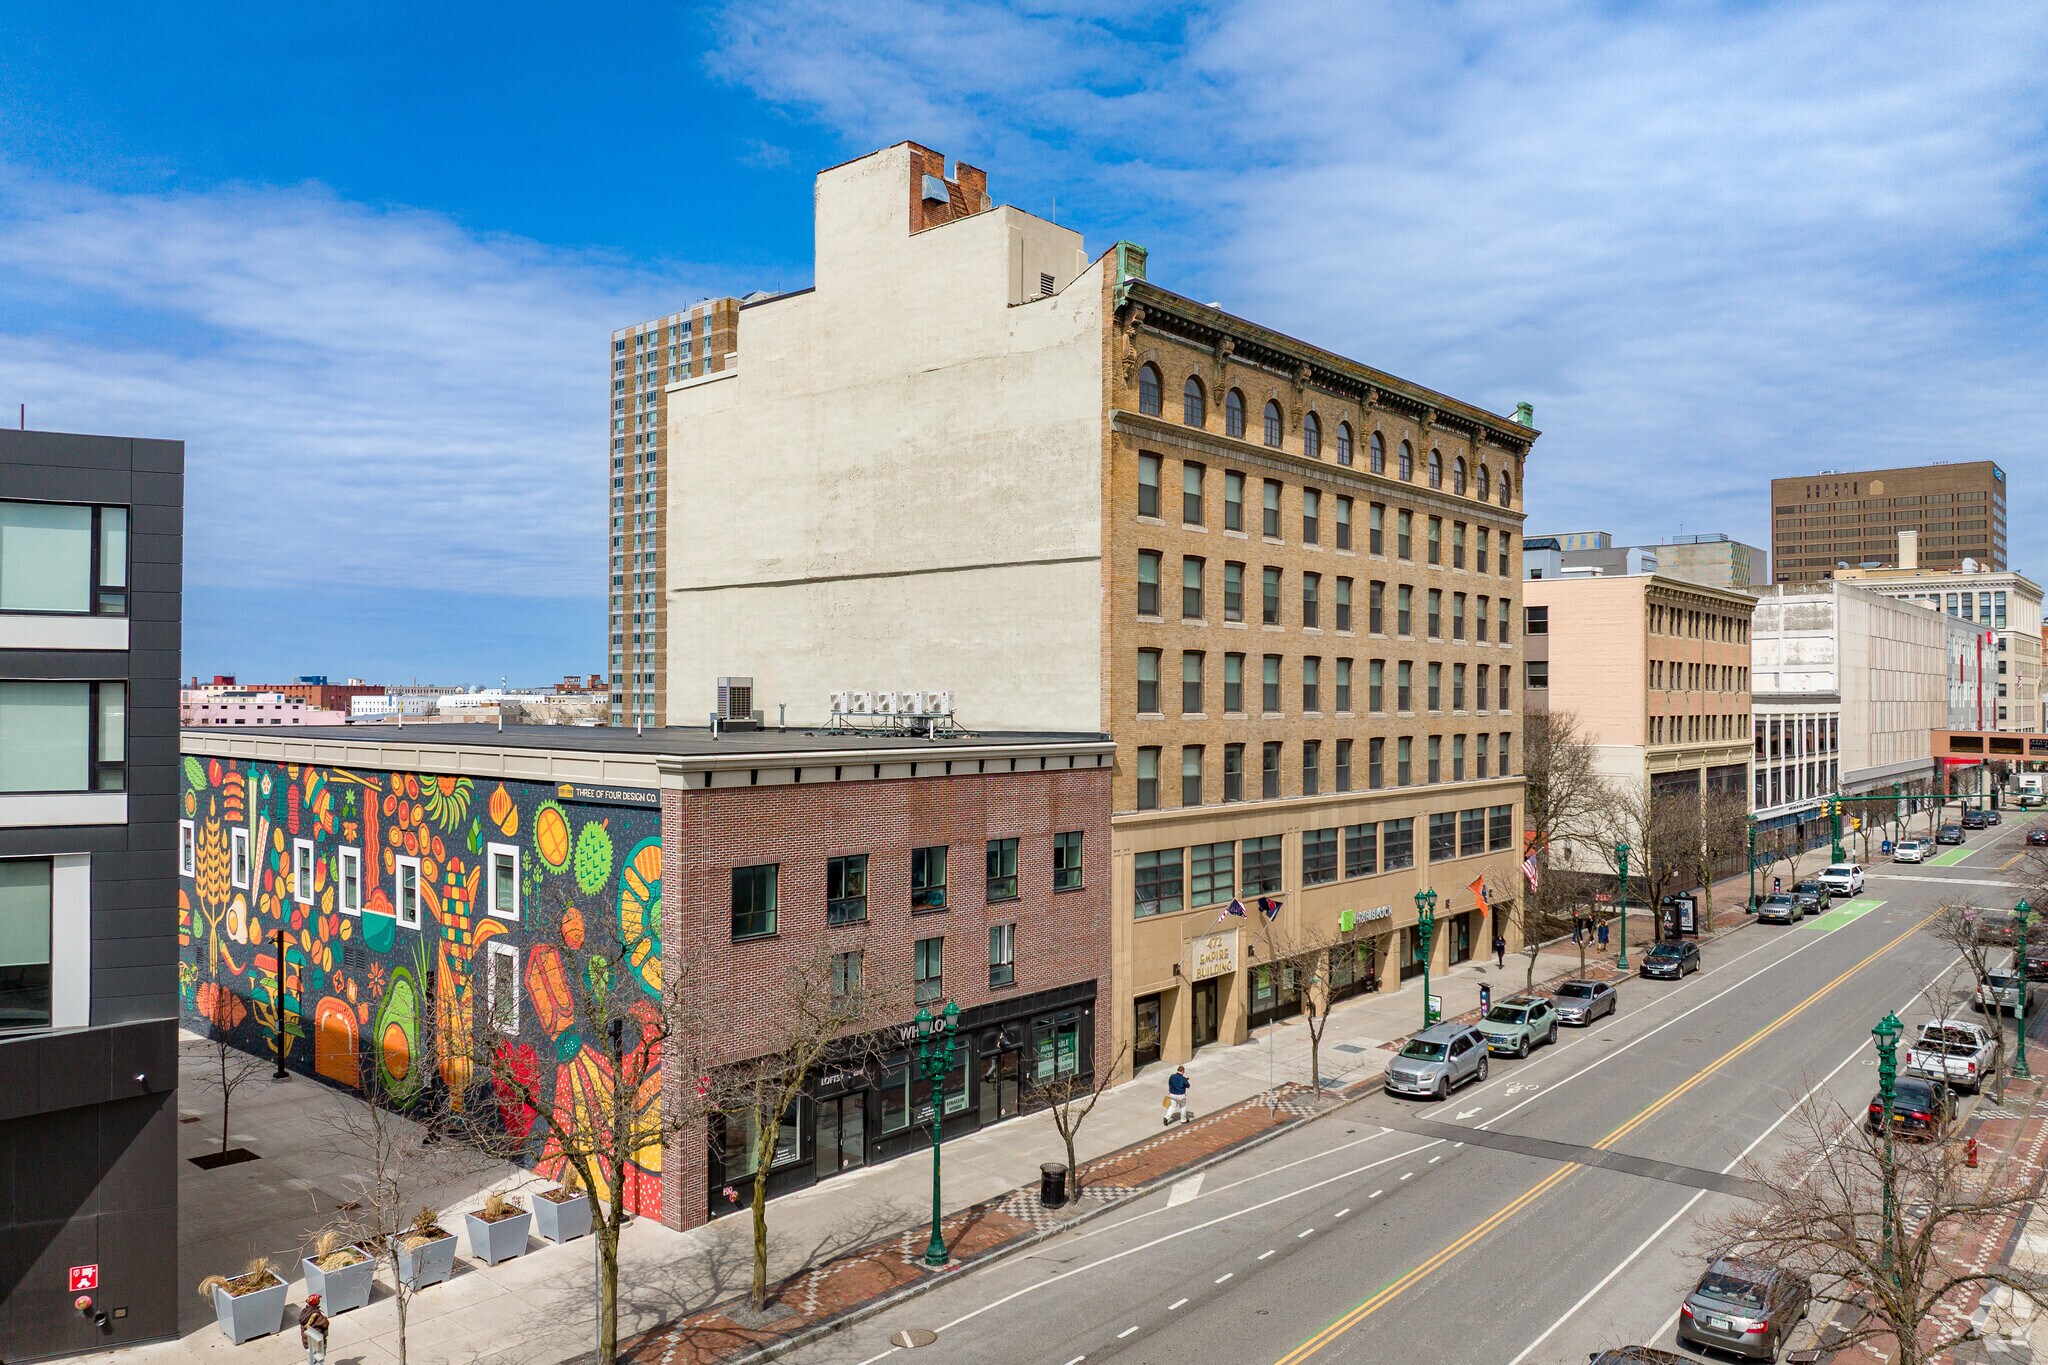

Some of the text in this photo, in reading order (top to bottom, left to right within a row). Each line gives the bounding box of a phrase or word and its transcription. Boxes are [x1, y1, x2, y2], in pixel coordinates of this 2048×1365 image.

[575, 788, 595, 798] THREE
[596, 790, 605, 798] OF
[605, 791, 622, 800] FOUR
[622, 792, 646, 802] DESIGN
[646, 793, 657, 803] CO.
[1371, 904, 1393, 920] BLOCK
[1206, 936, 1223, 949] 472
[1200, 948, 1229, 965] EMPIRE
[1196, 960, 1232, 979] BUILDING
[820, 1074, 841, 1086] LOFTS
